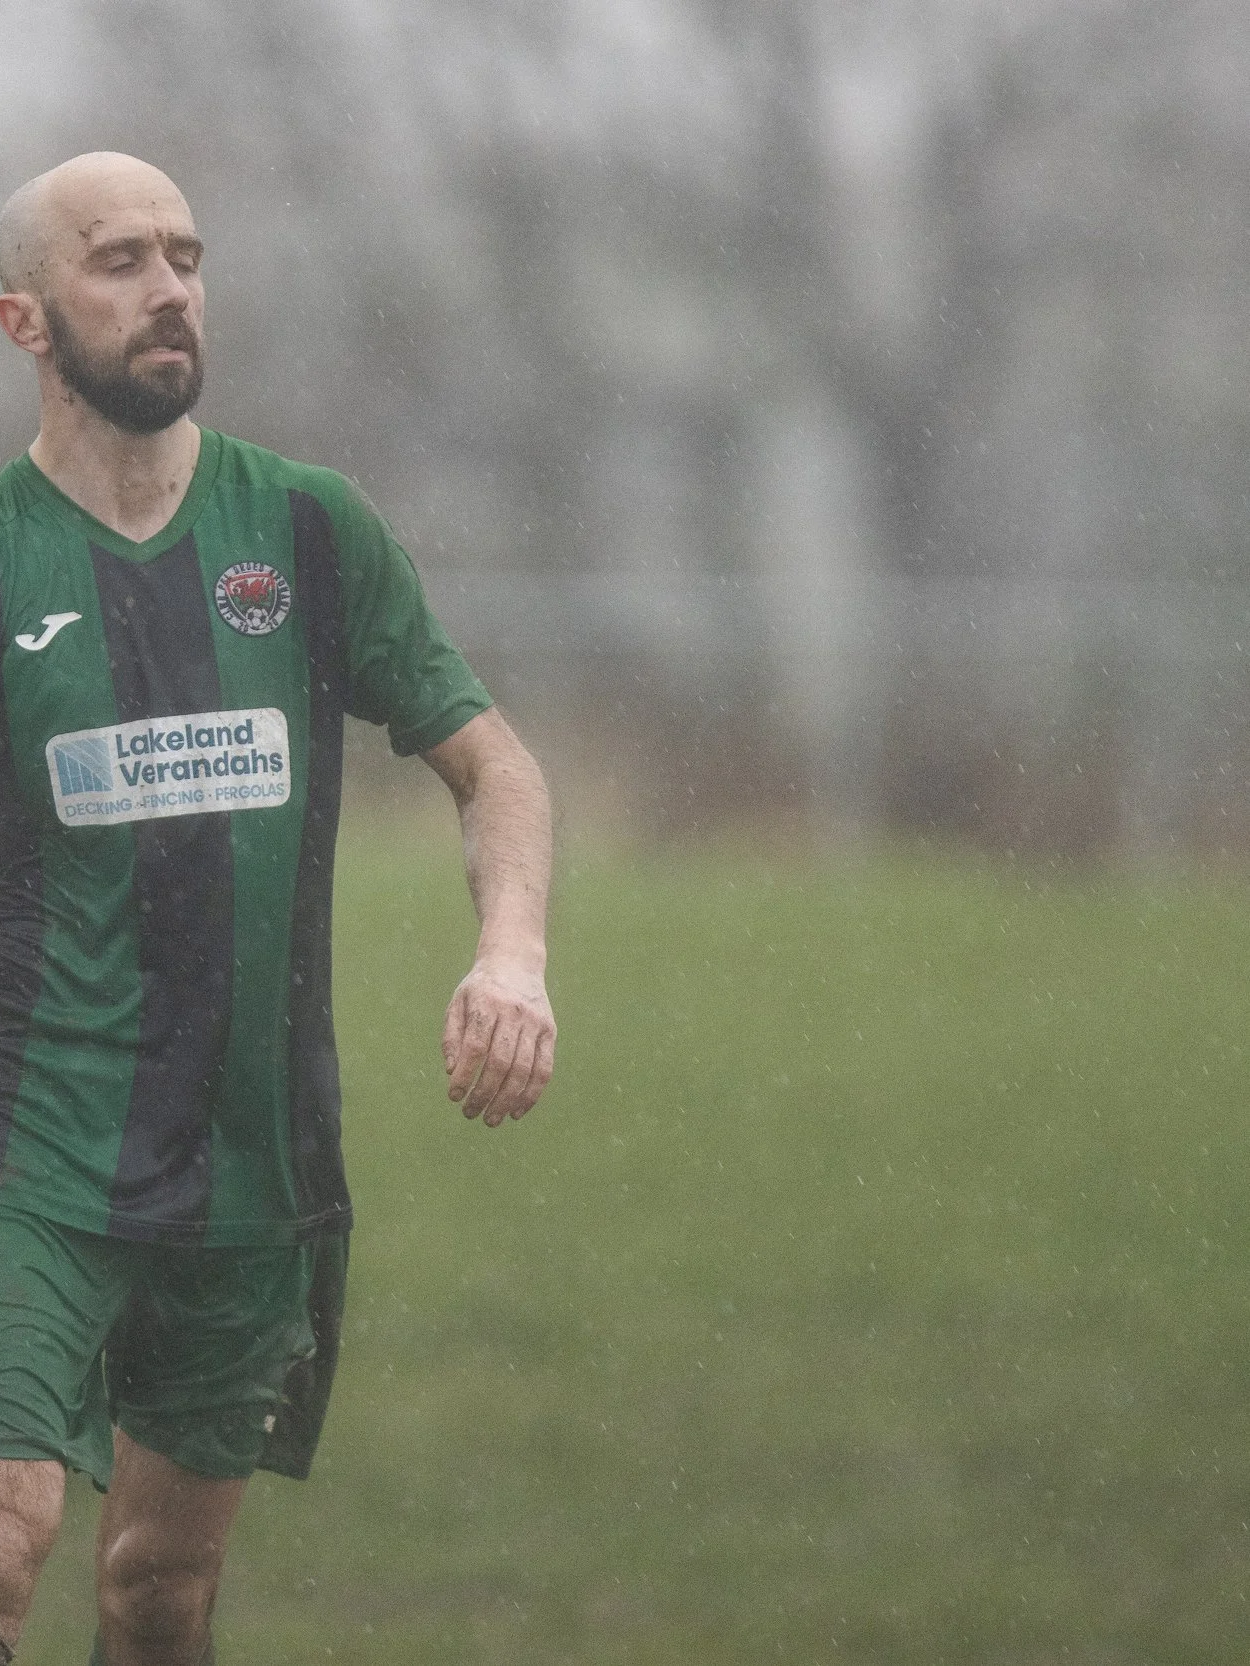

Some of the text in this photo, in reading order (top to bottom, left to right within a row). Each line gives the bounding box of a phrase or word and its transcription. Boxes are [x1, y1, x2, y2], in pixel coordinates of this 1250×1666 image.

[115, 718, 254, 759] Lakeland
[119, 748, 285, 787] Verandahs
[64, 798, 133, 818] DECKING
[215, 782, 286, 801] PERGOLAS
